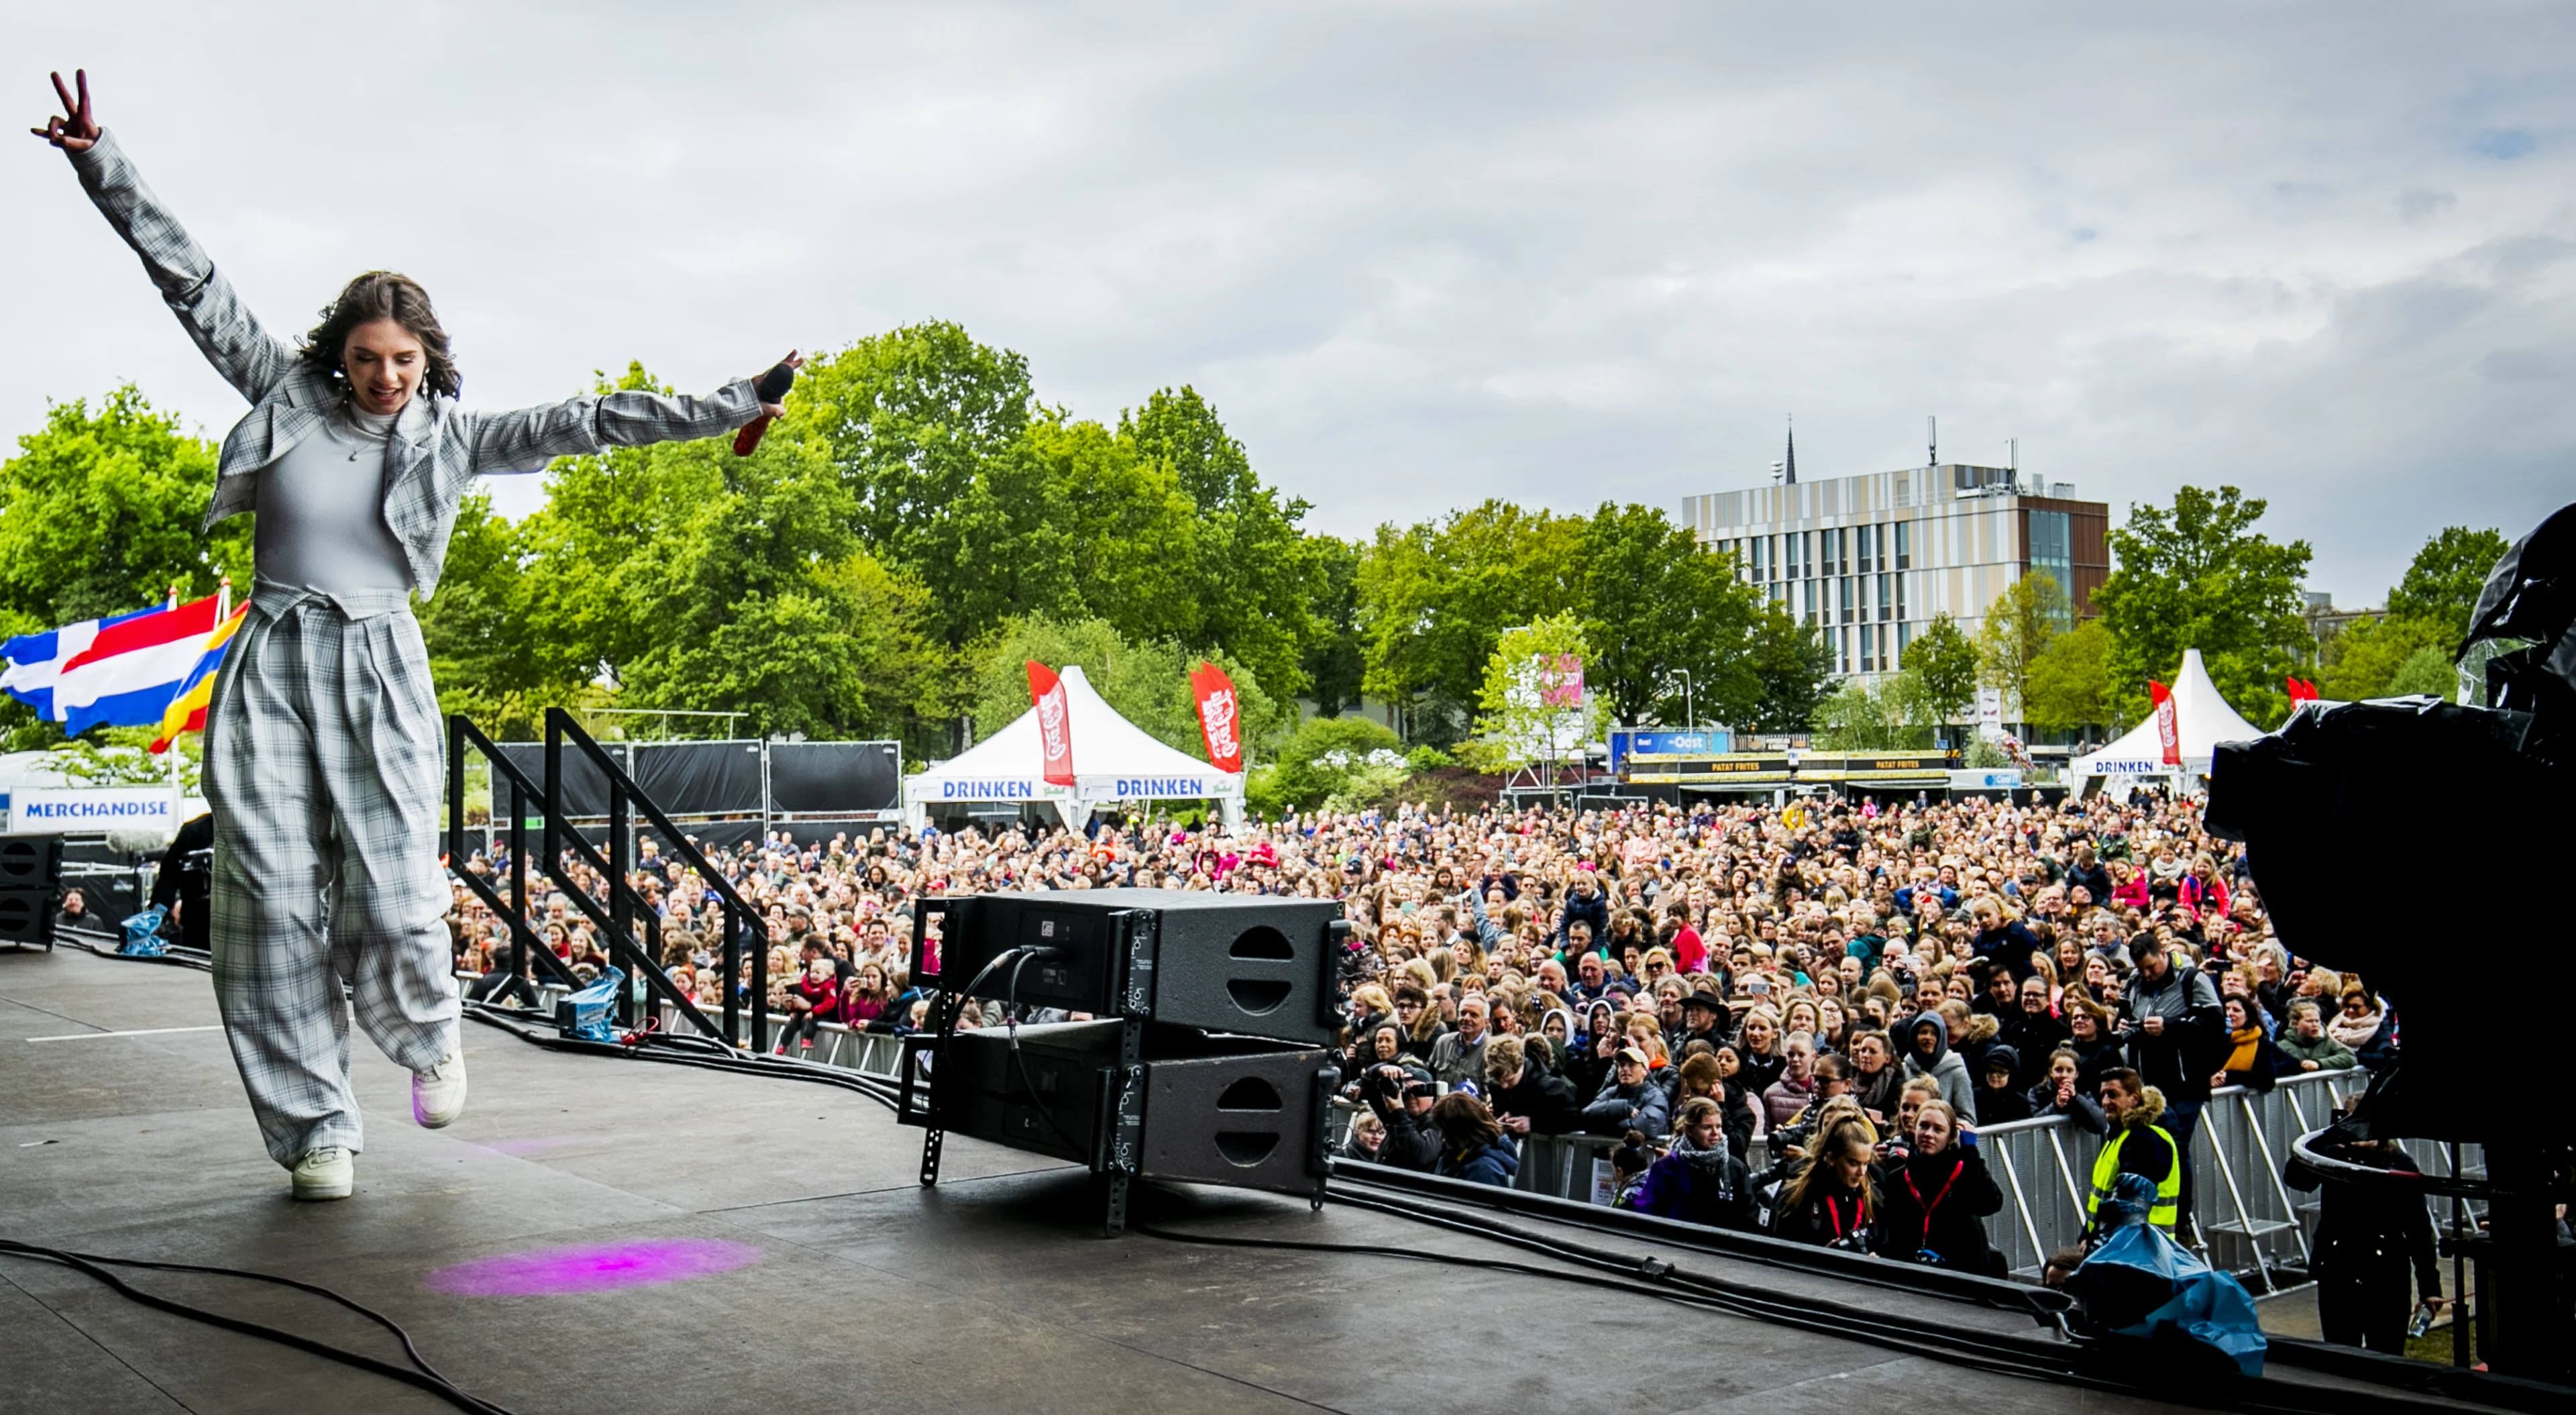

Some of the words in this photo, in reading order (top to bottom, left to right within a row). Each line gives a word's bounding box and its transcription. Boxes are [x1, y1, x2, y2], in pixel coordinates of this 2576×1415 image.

[1712, 763, 1734, 771] PATAT
[1735, 762, 1760, 771] FRITES
[1876, 761, 1896, 769] PATAT
[1897, 760, 1919, 768] FRITES
[2096, 762, 2153, 773] DRINKEN
[943, 781, 1032, 798] DRINKEN
[1117, 779, 1202, 796] DRINKEN
[27, 801, 168, 818] MERCHANDISE
